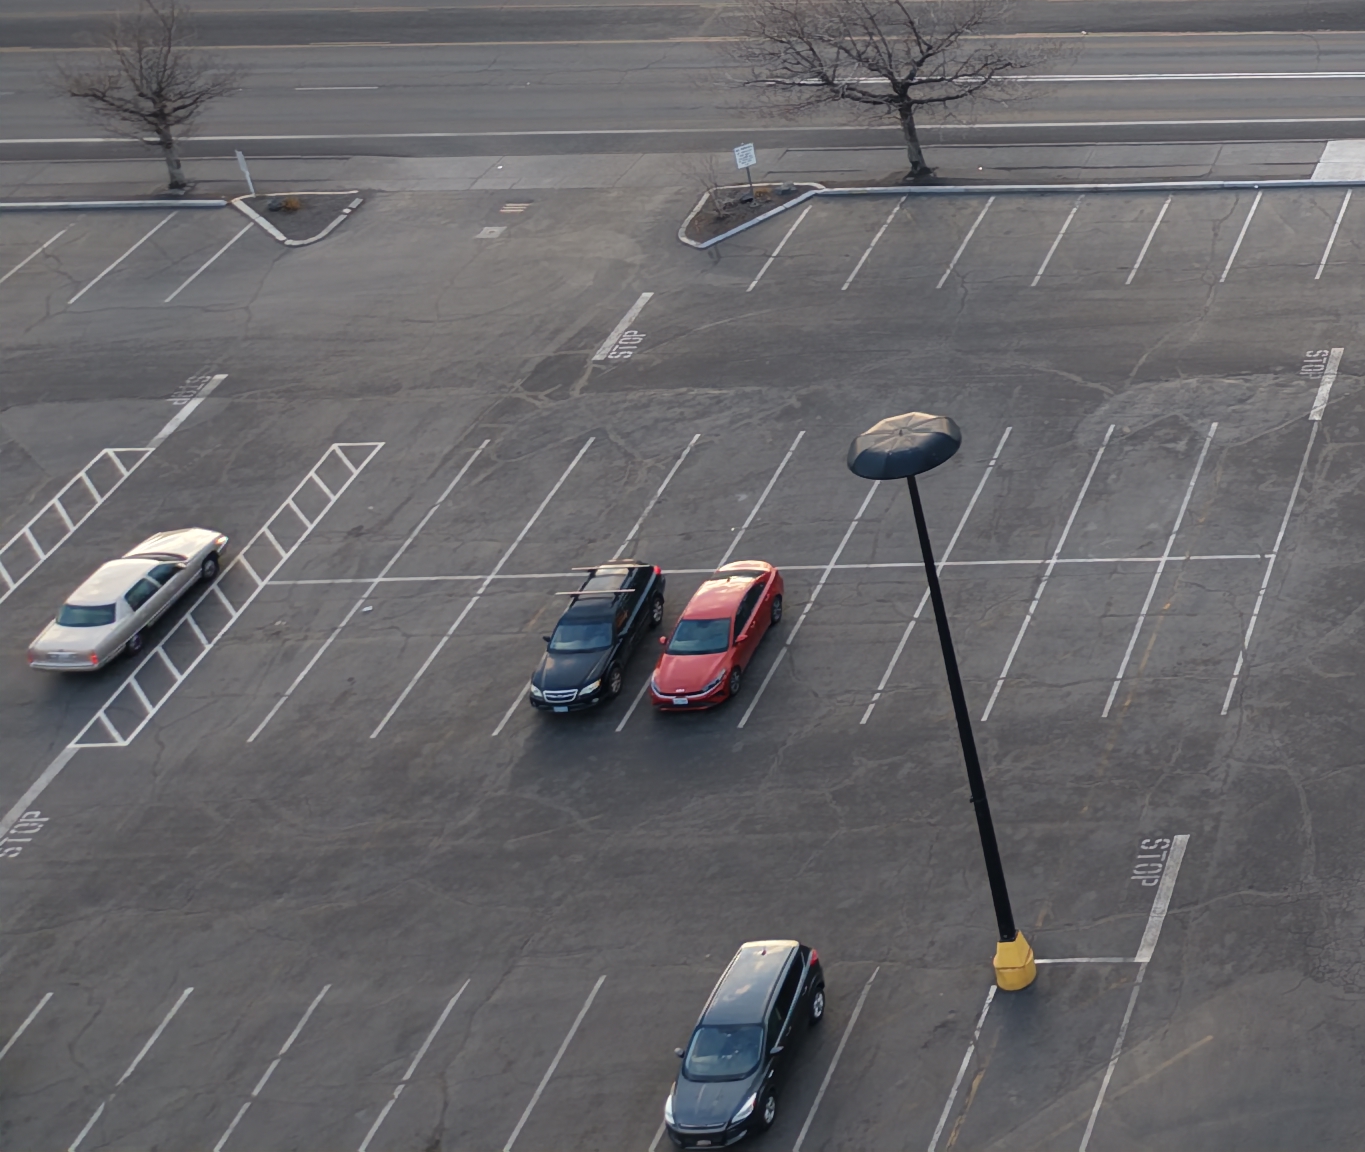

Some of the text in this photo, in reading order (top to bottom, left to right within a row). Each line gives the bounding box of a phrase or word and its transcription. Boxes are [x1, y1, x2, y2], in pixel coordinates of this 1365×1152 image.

[607, 330, 646, 359] STOP
[1299, 349, 1329, 379] STOP
[1130, 838, 1171, 886] STOP
